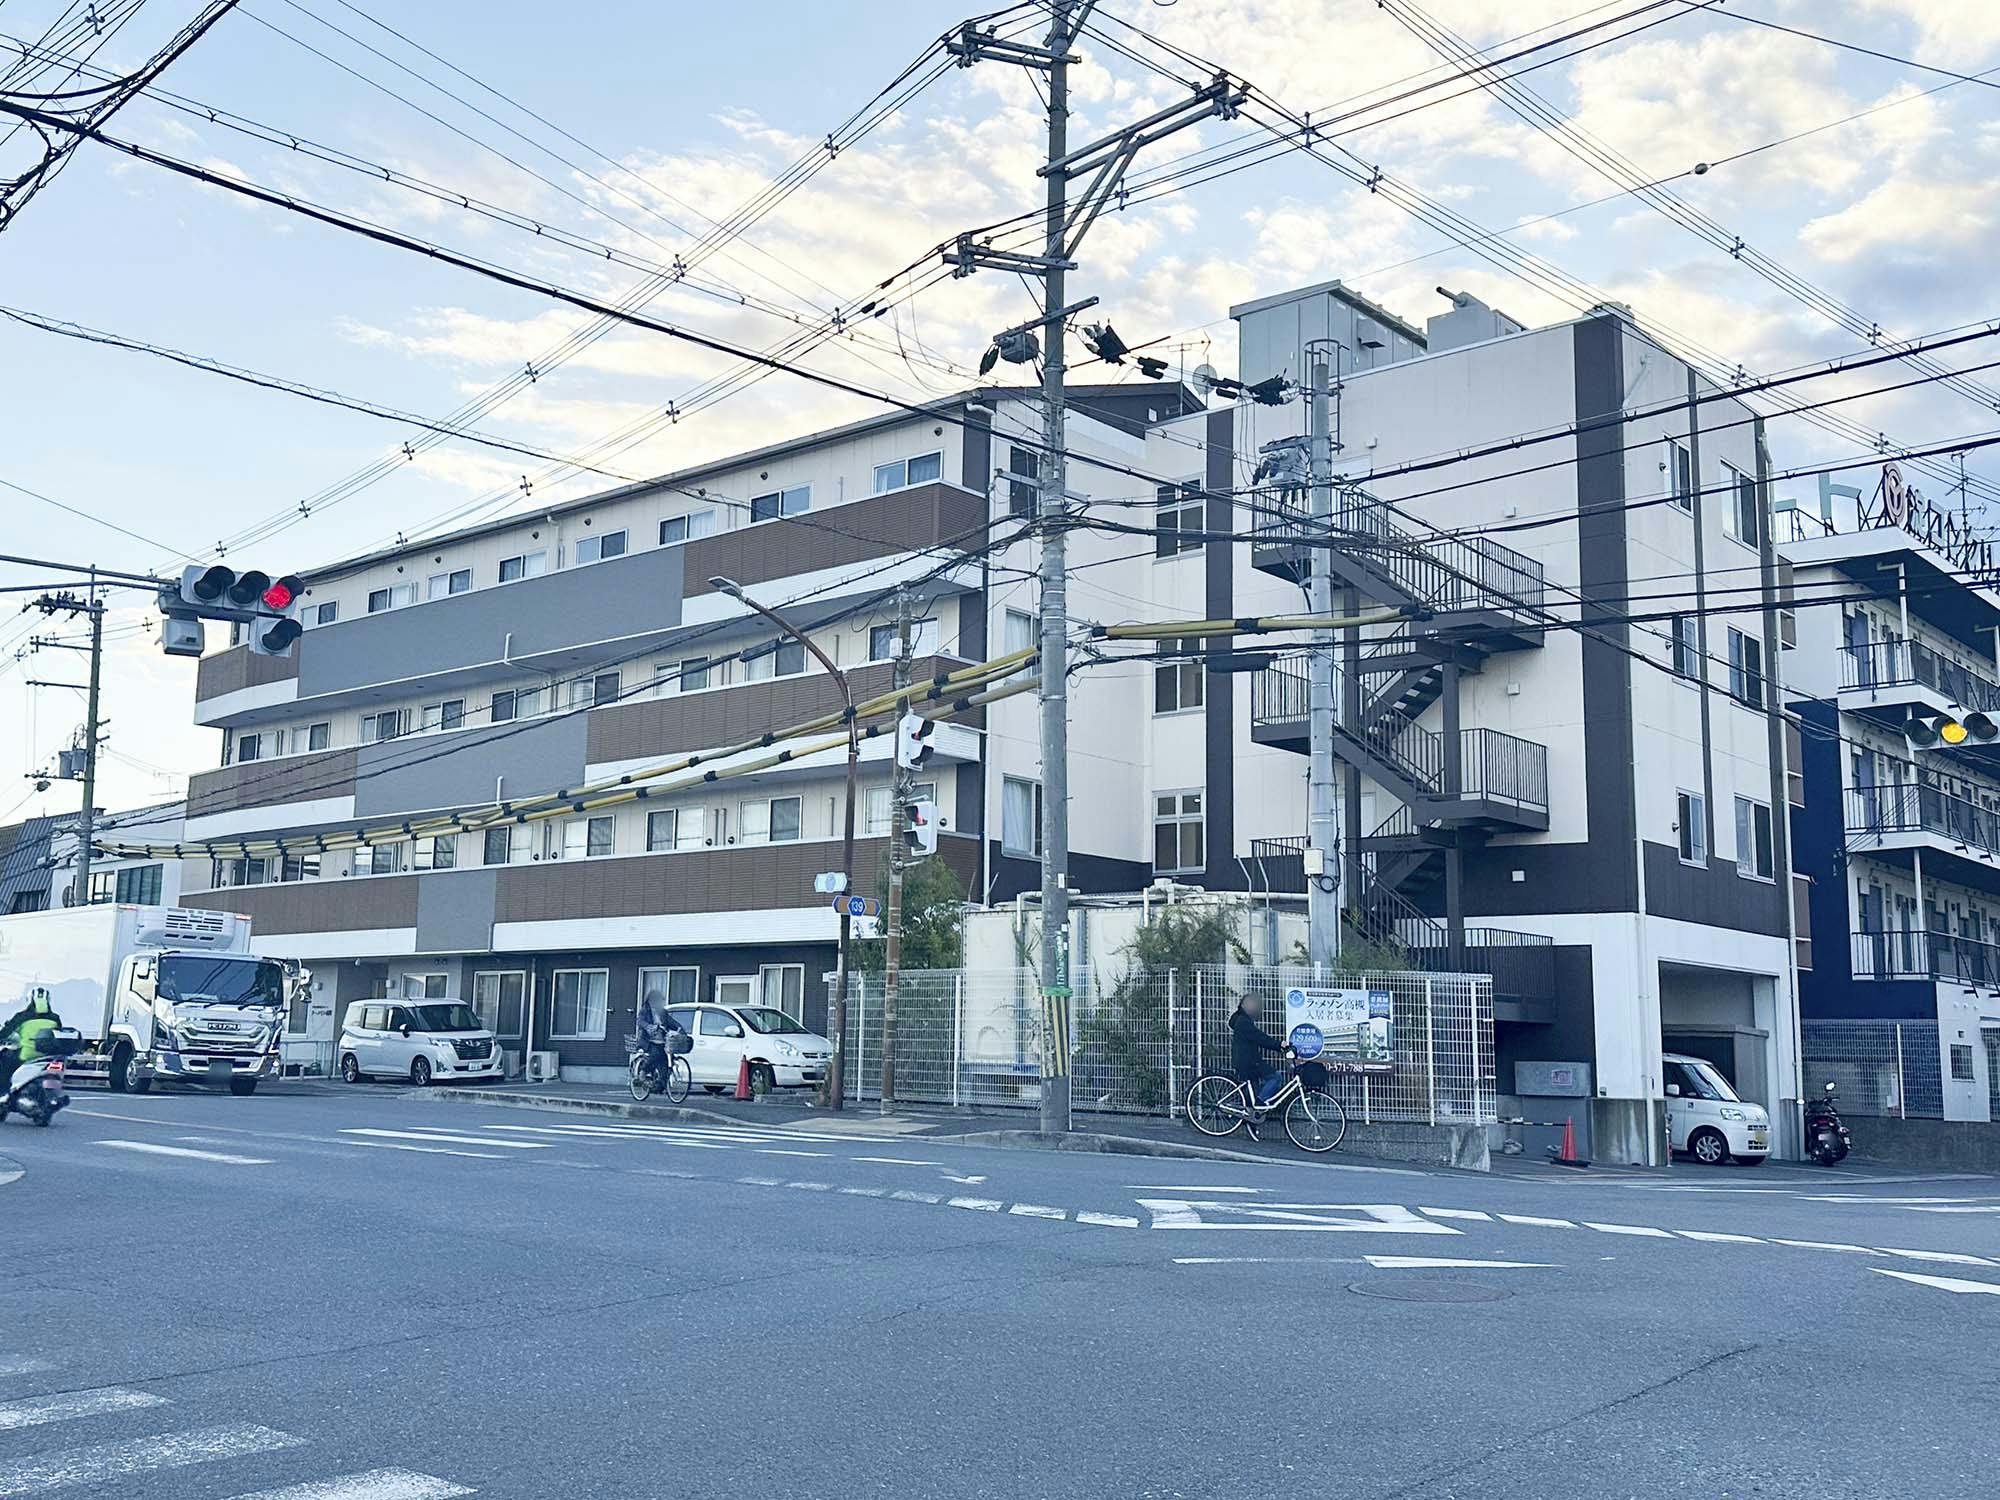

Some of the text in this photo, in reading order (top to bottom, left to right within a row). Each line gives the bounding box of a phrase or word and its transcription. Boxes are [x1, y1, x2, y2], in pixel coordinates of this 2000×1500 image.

[850, 901, 864, 913] 139
[1305, 1009, 1354, 1021] 入居者募集
